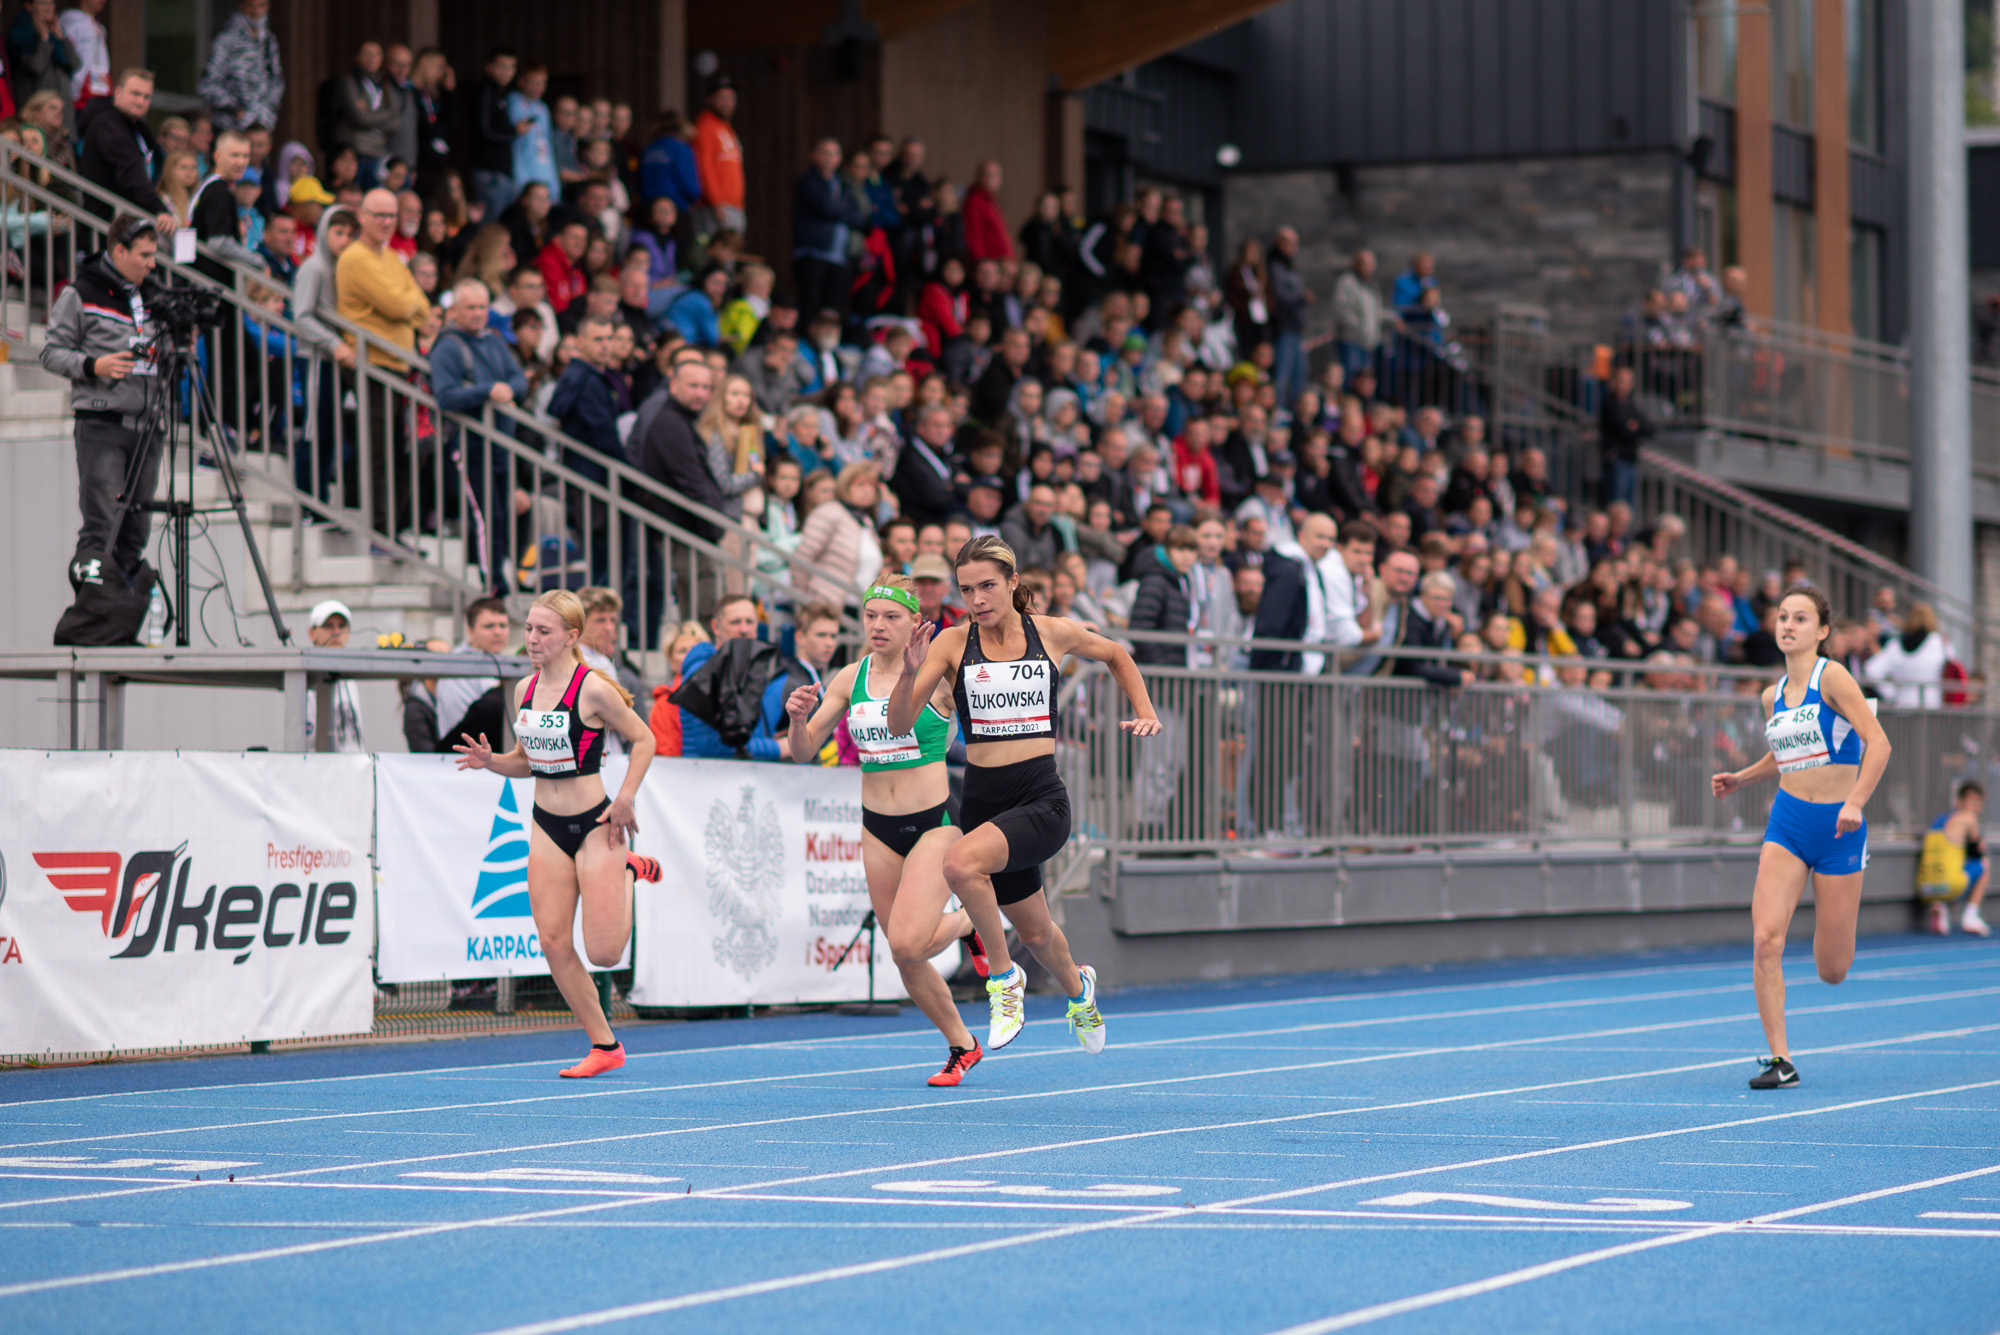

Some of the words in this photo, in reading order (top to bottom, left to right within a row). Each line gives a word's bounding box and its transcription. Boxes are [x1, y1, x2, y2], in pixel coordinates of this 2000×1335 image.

[1010, 664, 1045, 680] 704
[970, 690, 1045, 710] ŻUKOWSKA
[539, 714, 564, 728] 553
[1792, 708, 1815, 724] 456
[851, 727, 913, 742] MAJEWS
[982, 724, 1019, 734] KARPACZ
[1021, 723, 1039, 732] 2021
[892, 752, 910, 761] 2021
[1804, 759, 1820, 769] 2021
[549, 763, 565, 772] 2021
[805, 831, 864, 862] Kultur
[267, 842, 352, 875] Prestigeauto
[805, 870, 868, 894] Dziedzic
[110, 838, 358, 965] Okęcie
[467, 934, 545, 961] KARPAC
[396, 1167, 685, 1184] 4
[870, 1179, 1183, 1198] 3
[1357, 1191, 1695, 1212] 2
